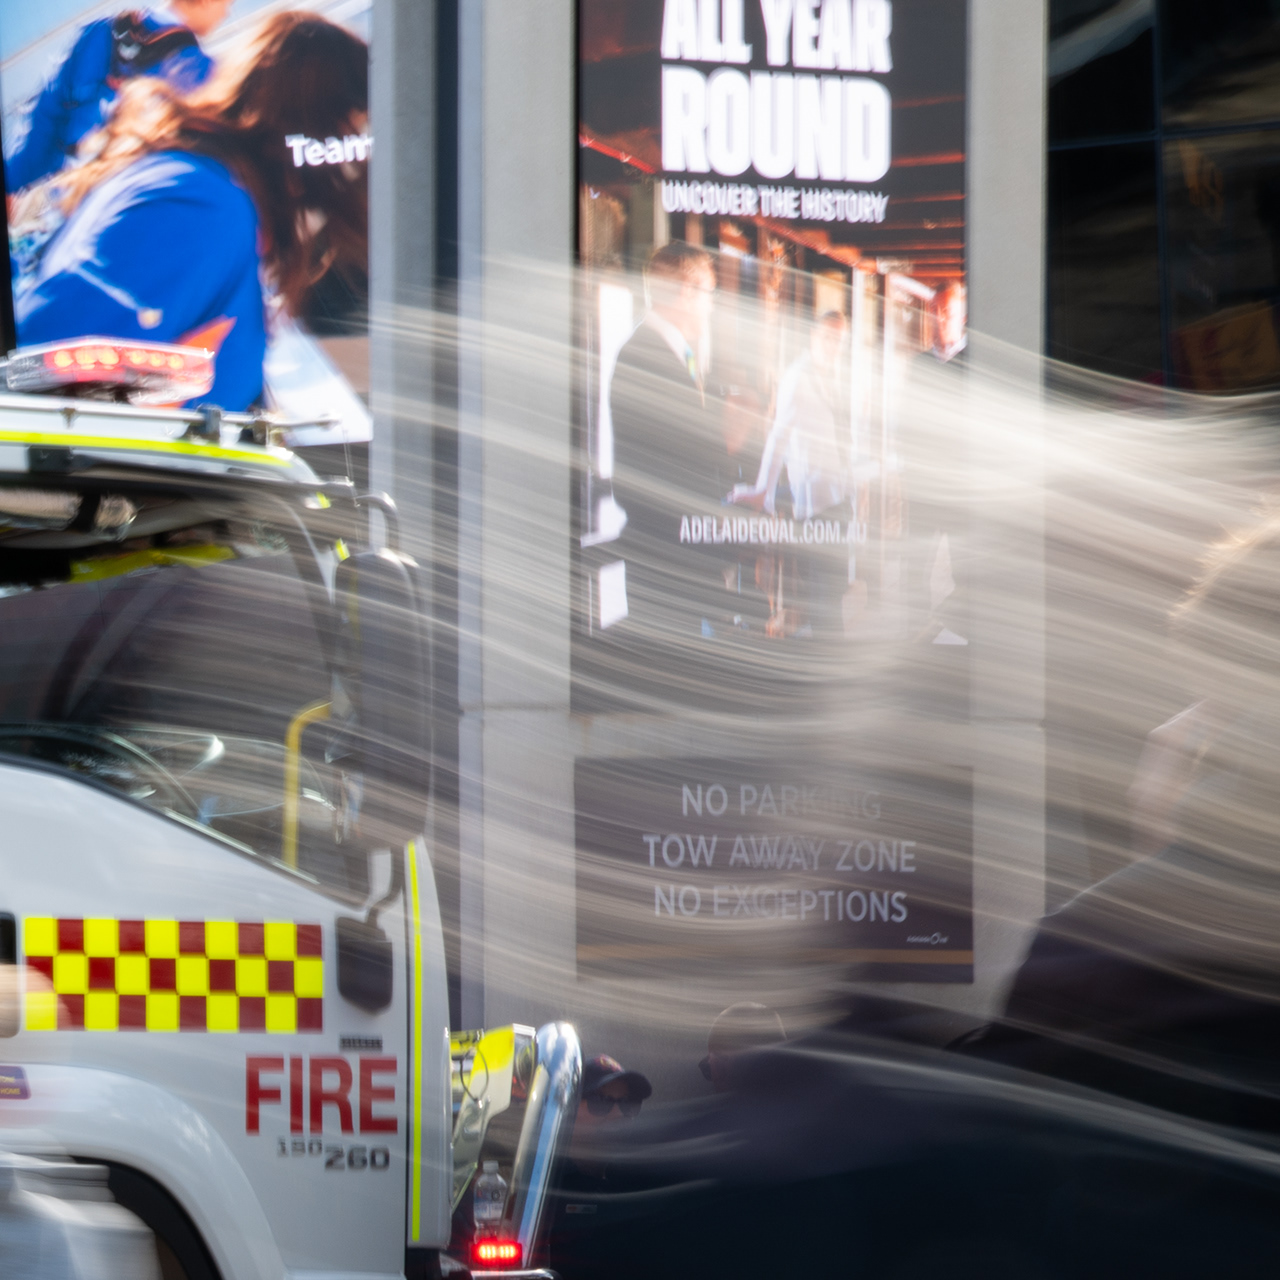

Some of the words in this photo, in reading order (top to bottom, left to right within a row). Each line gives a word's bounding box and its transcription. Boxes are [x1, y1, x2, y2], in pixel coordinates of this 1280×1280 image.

[660, 0, 753, 65] ALL
[759, 0, 894, 73] YEAR
[661, 64, 892, 182] ROUND
[661, 178, 758, 216] UNCOVER
[759, 185, 800, 219] THE
[801, 187, 889, 224] HISTORY
[679, 514, 868, 544] ADELAIDEOVAL.COM.AU
[681, 783, 729, 817] NO
[642, 833, 718, 867] TOW
[728, 834, 827, 871] AWAY
[834, 840, 917, 873] ZONE
[653, 884, 702, 917] NO
[712, 885, 909, 923] EXCEPTIONS
[245, 1056, 399, 1136] FIRE
[324, 1144, 391, 1171] 260
